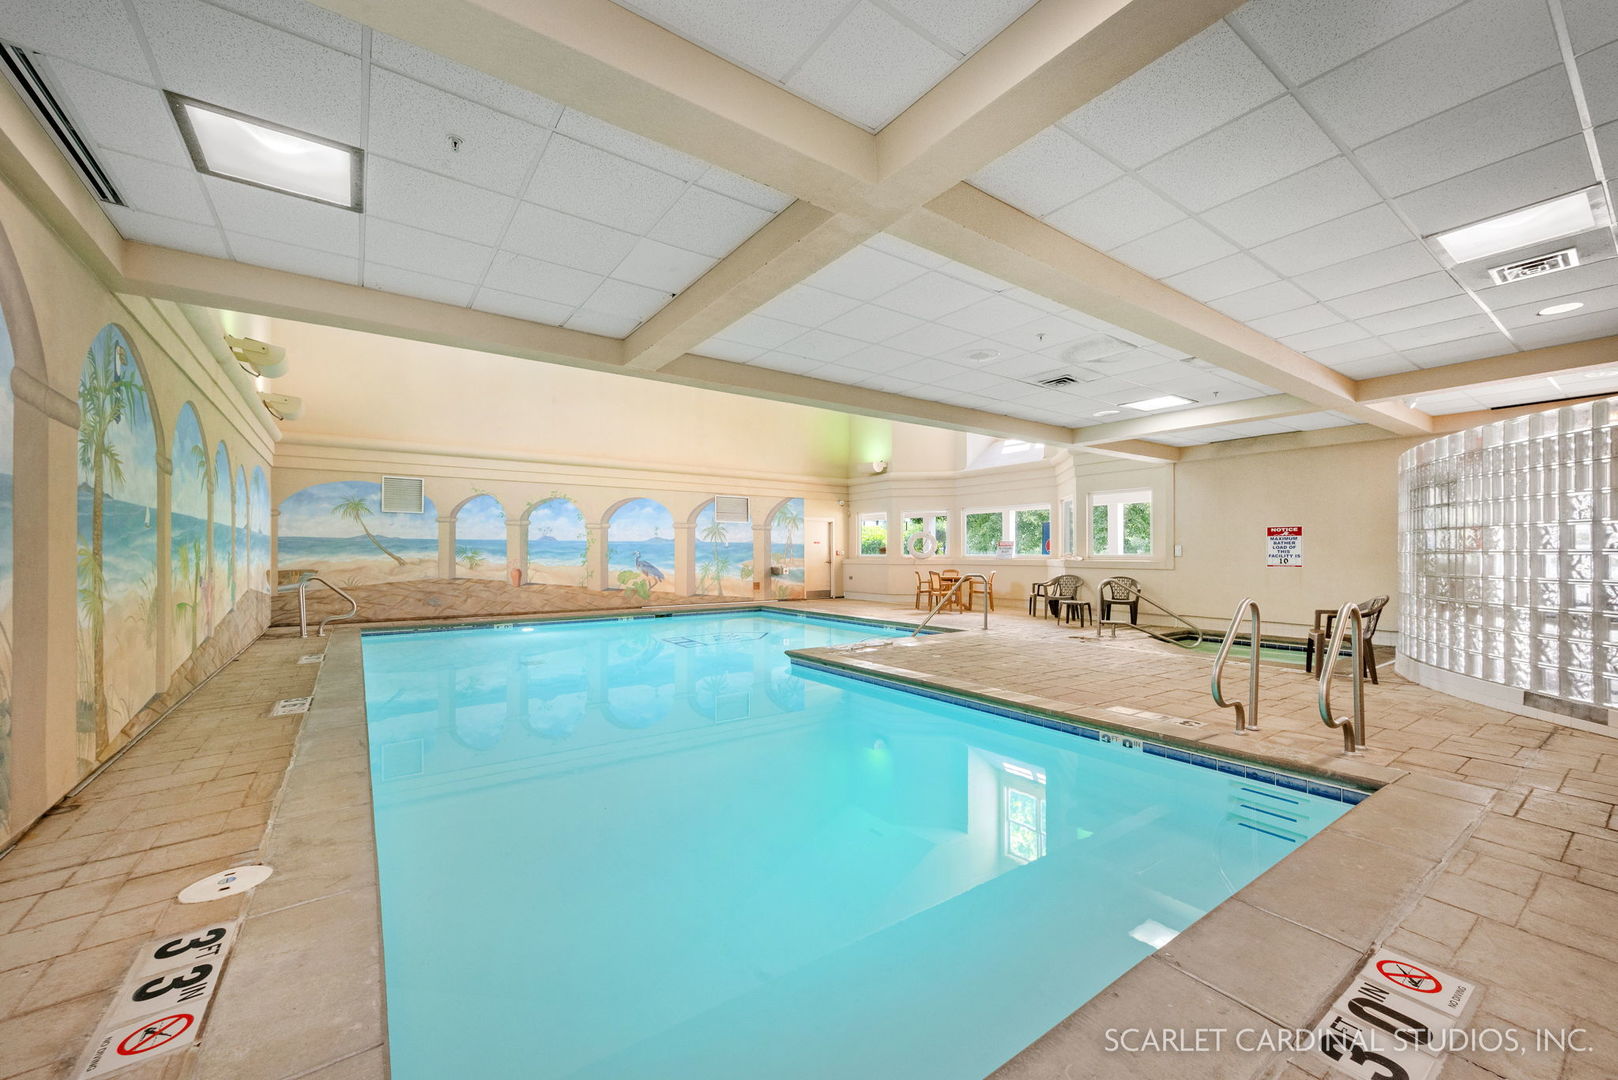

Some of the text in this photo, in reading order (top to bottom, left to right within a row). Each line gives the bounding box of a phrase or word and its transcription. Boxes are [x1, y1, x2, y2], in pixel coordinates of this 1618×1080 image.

[132, 927, 227, 1003] 3 FT 3 IN
[1447, 985, 1467, 1010] NO DIVING
[1321, 982, 1433, 1080] 3 FT 0 IN
